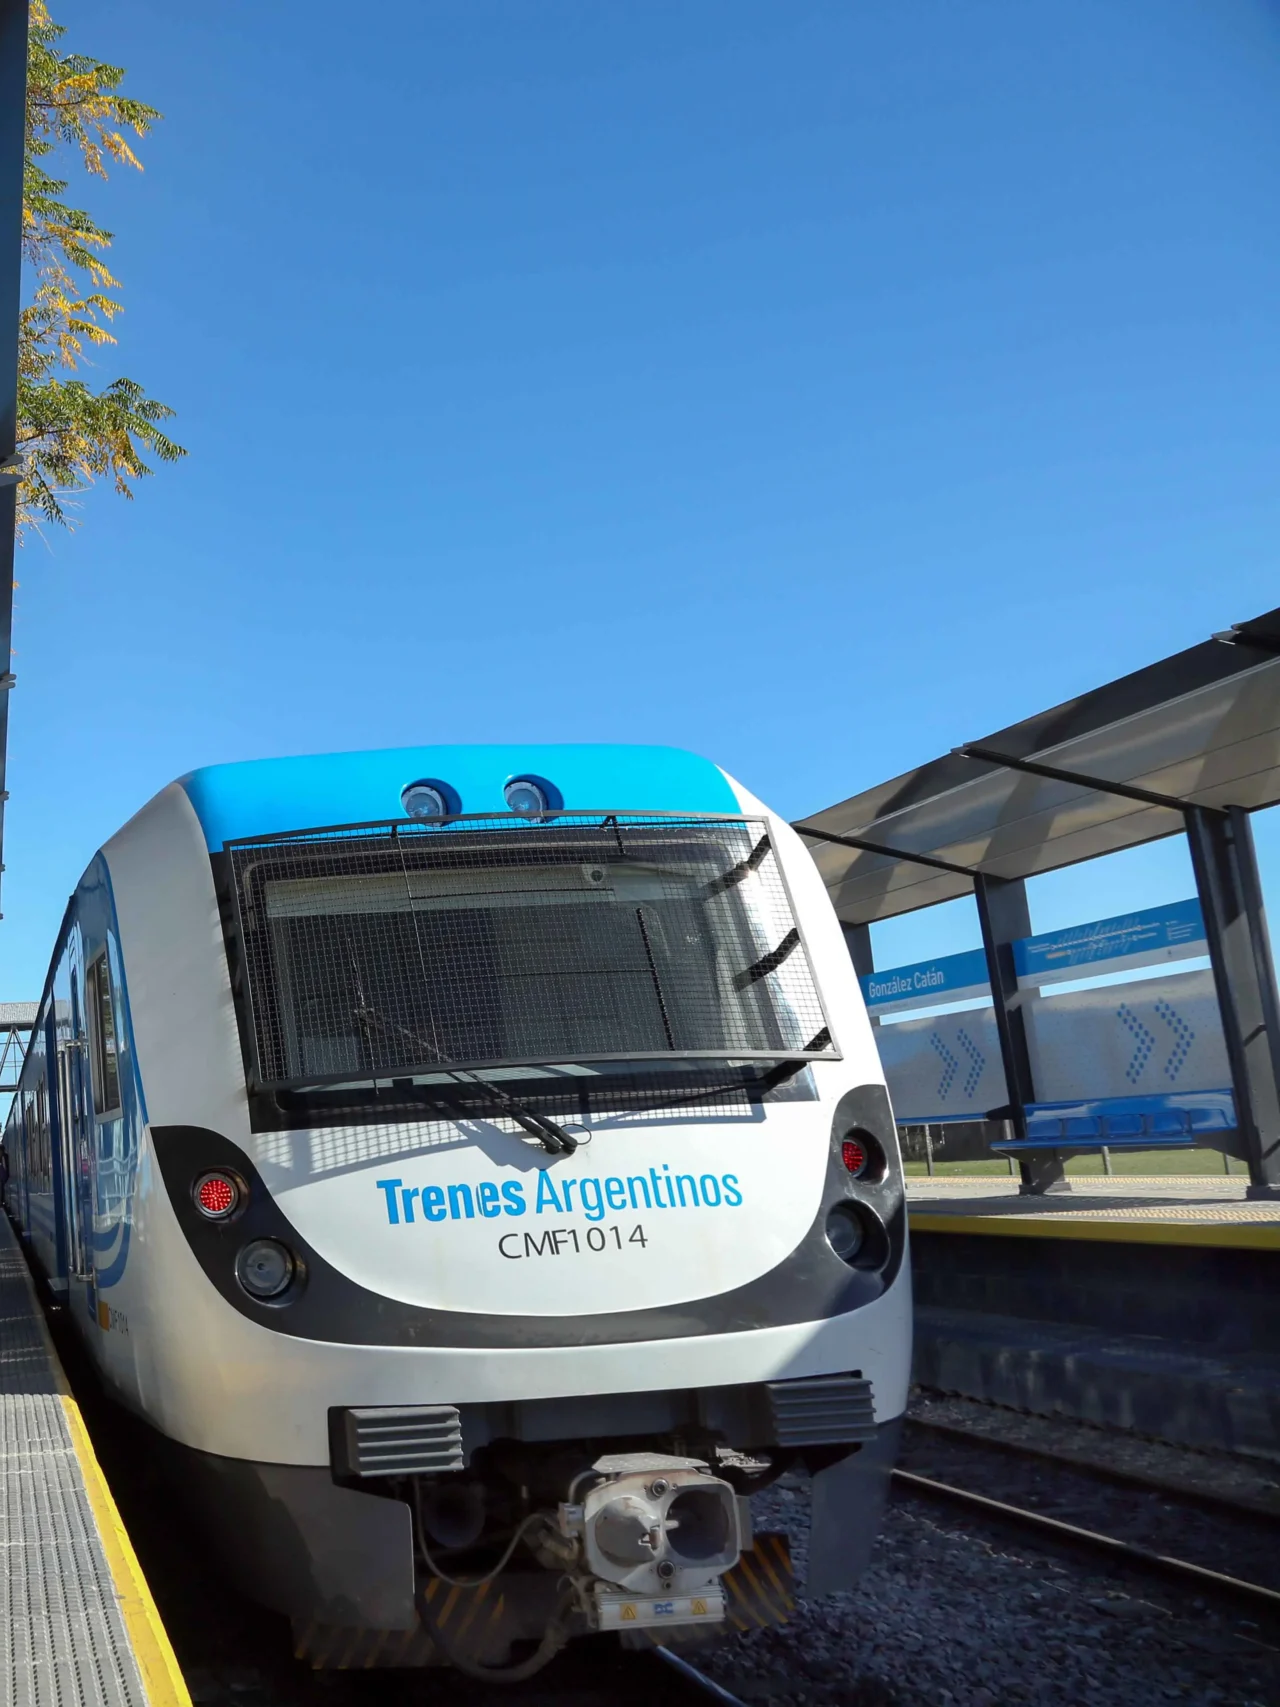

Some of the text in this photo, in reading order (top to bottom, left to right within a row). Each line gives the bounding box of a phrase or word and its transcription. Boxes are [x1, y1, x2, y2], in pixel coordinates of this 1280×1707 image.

[868, 966, 944, 998] González Catán
[375, 1163, 743, 1225] Trenes Argentinos
[497, 1223, 649, 1260] CMF1014
